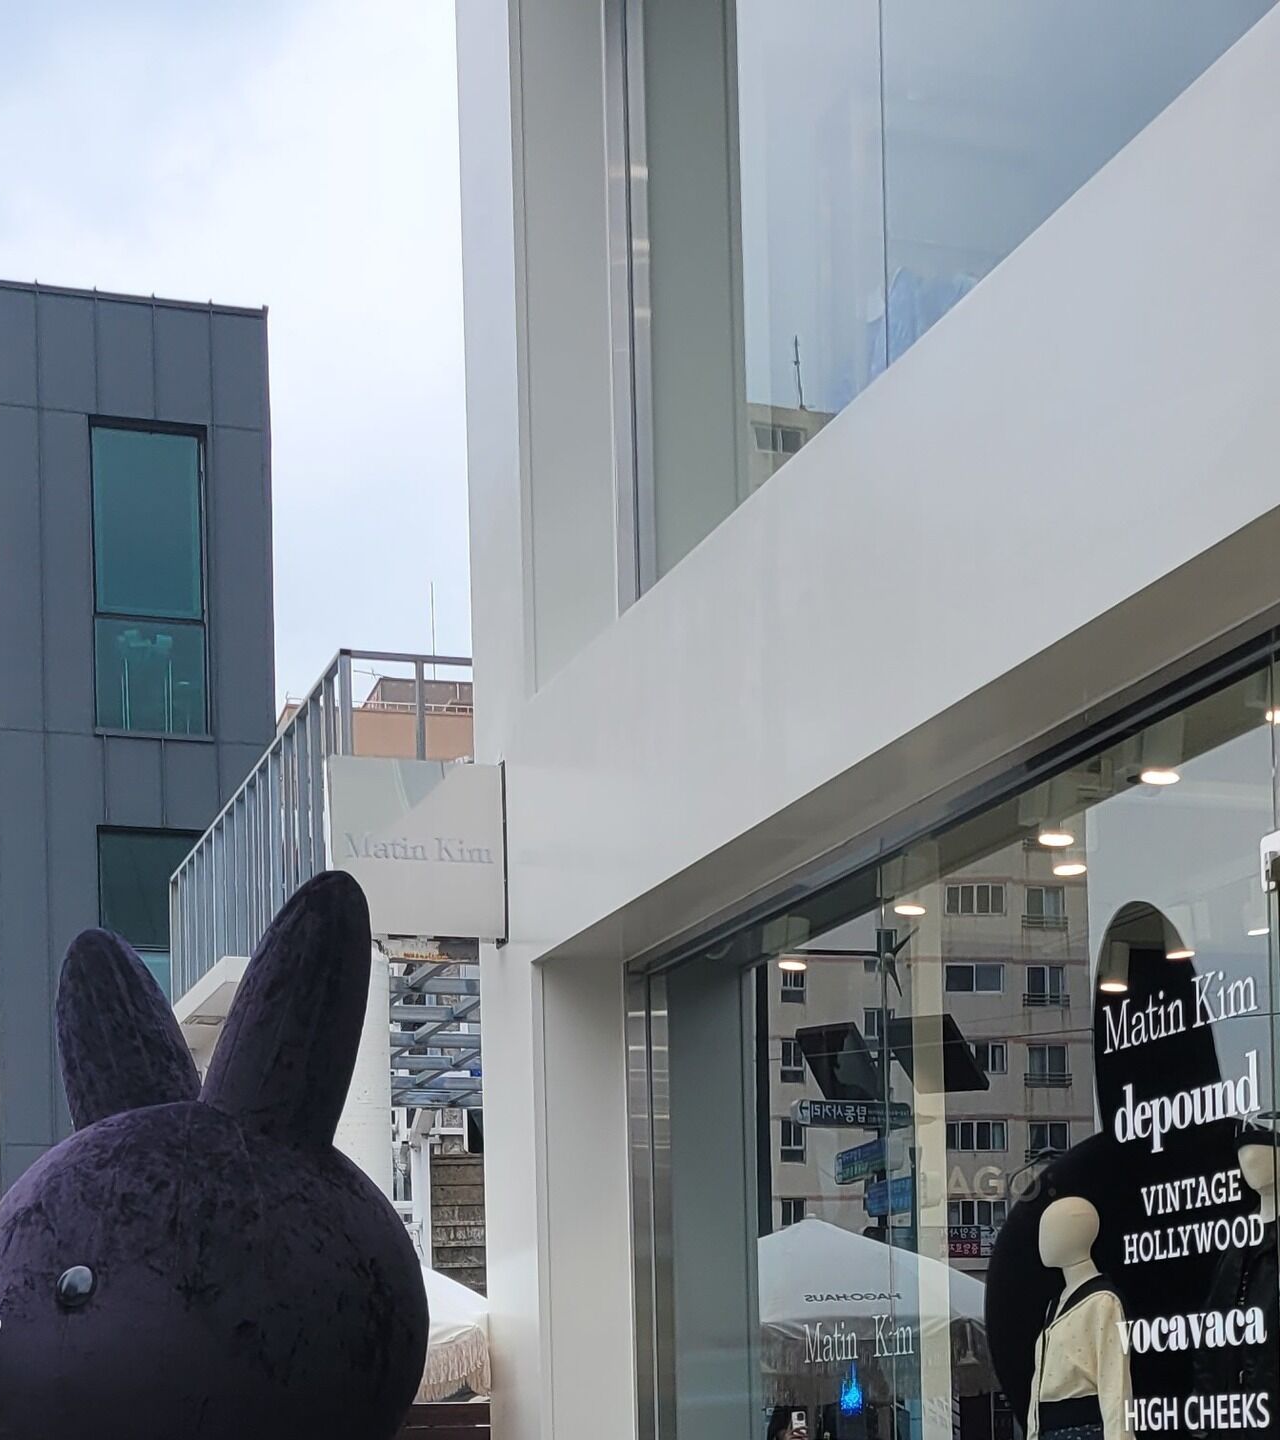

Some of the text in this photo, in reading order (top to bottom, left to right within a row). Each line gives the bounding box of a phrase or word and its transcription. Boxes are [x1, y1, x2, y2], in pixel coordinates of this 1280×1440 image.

[344, 832, 495, 864] Matin Kim
[1103, 970, 1258, 1054] Matin Kim
[1114, 1049, 1261, 1153] depound
[1141, 1169, 1242, 1216] VINTAGE
[1124, 1214, 1264, 1265] HOLLYWOOD
[803, 1321, 859, 1363] Matin
[1115, 1306, 1267, 1355] vocavaca
[1124, 1392, 1270, 1431] HIGH CHEEKS
